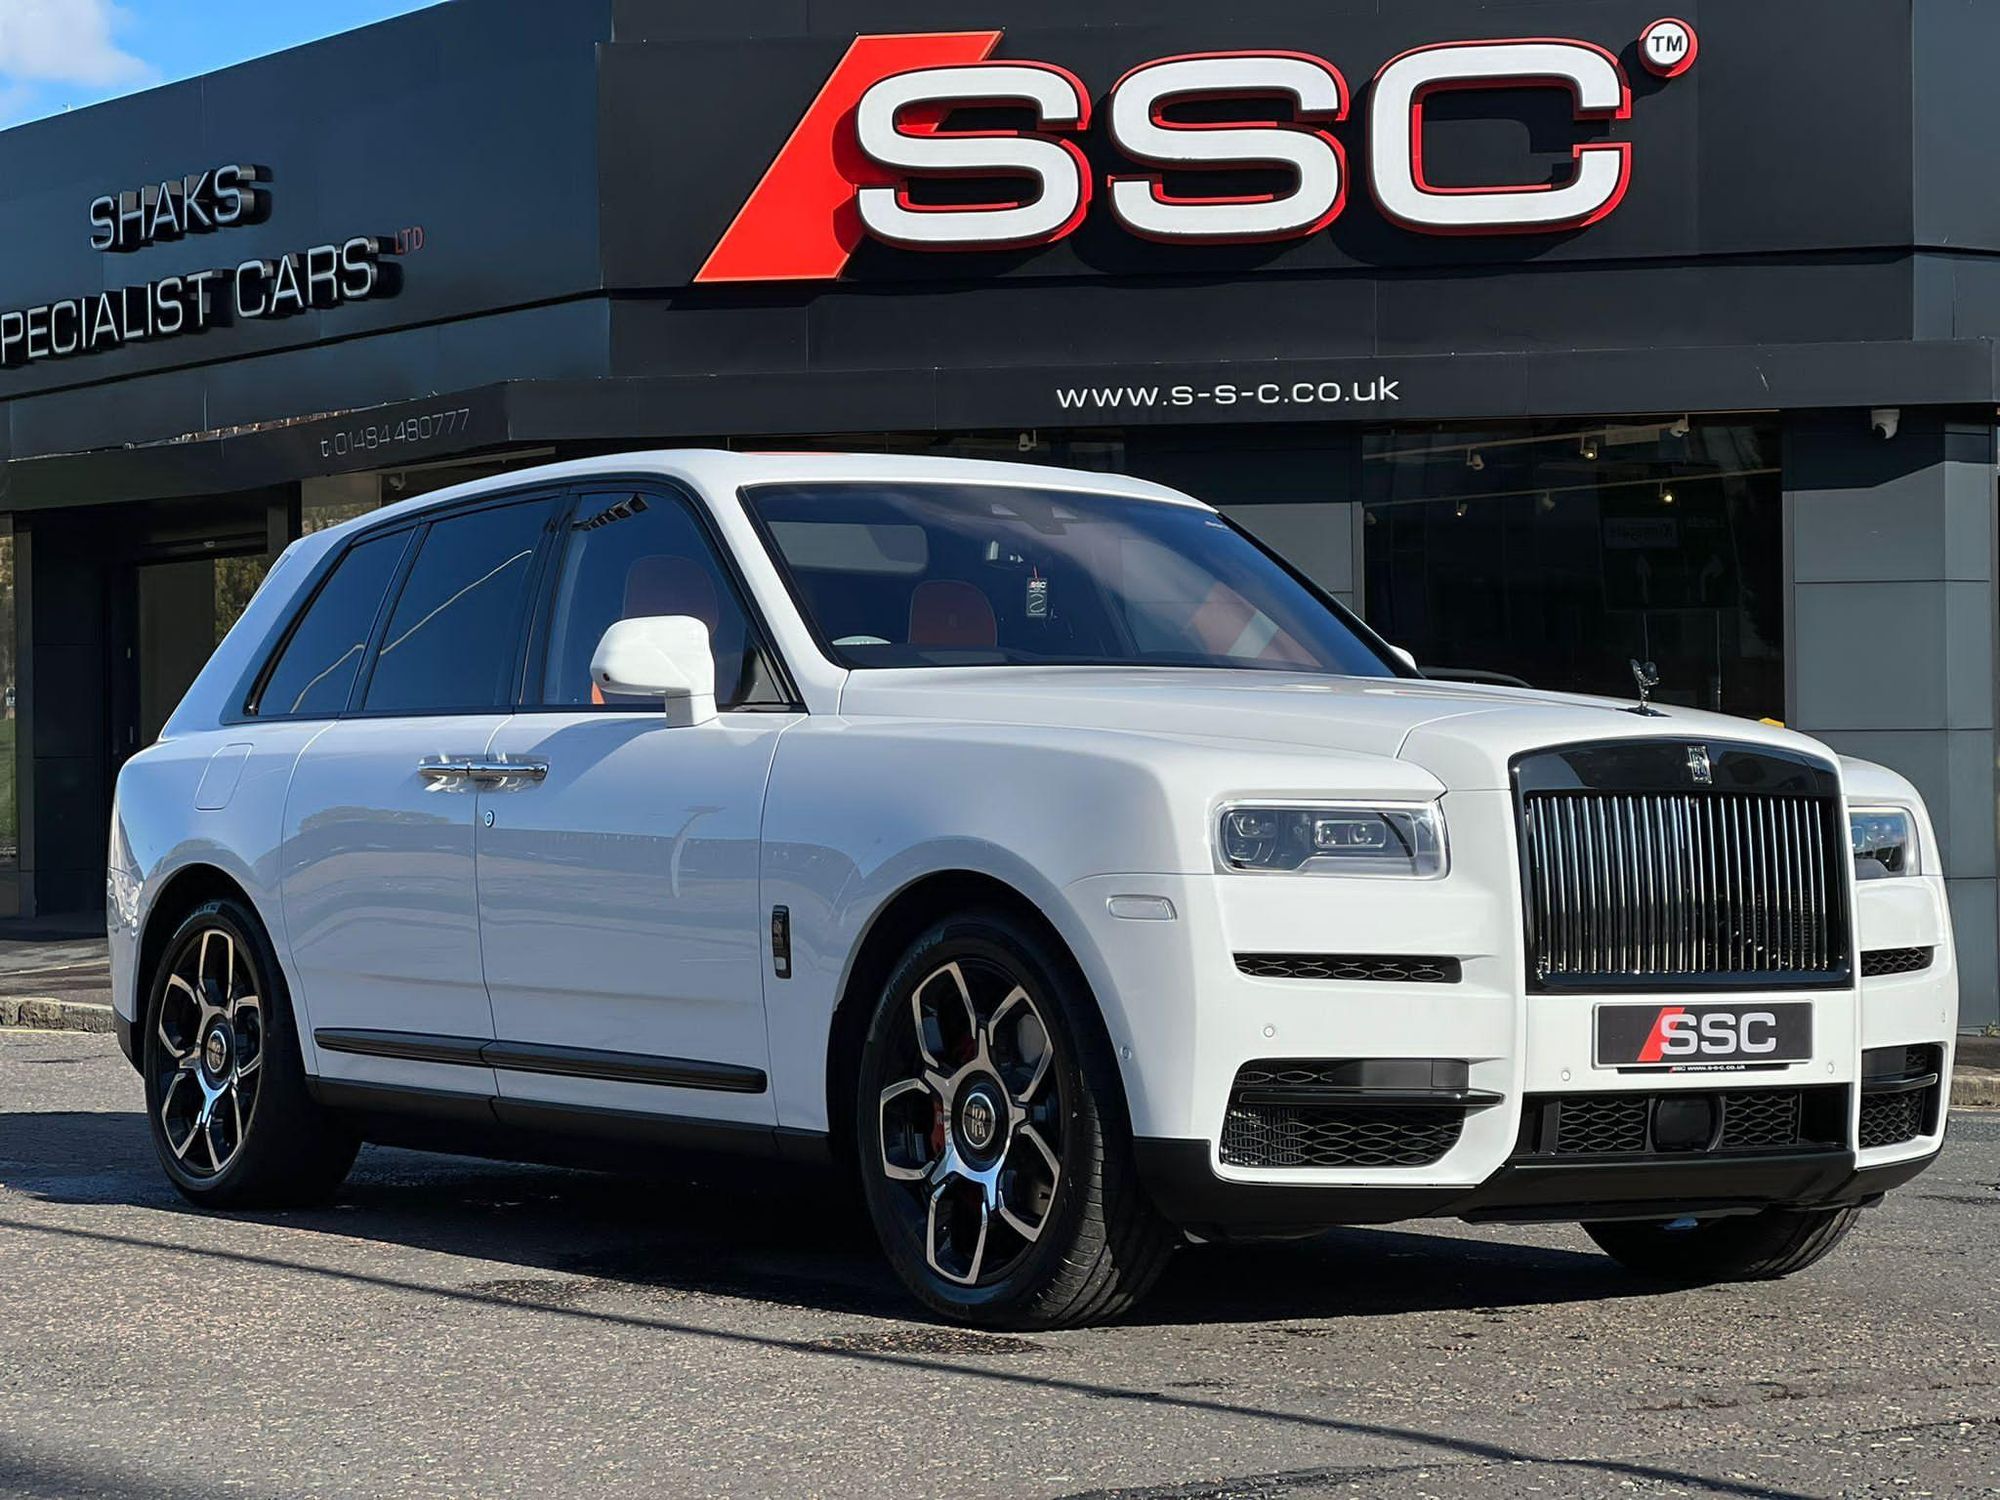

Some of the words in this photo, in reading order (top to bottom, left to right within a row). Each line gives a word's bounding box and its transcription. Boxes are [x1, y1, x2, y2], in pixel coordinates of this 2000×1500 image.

[854, 37, 1632, 246] SSC
[1651, 35, 1683, 53] TM
[90, 164, 247, 250] SHAKS
[235, 236, 375, 318] CARS
[394, 226, 424, 254] LTD
[1055, 375, 1401, 409] www.s-s-c.co.uk
[1660, 1012, 1777, 1055] SSC
